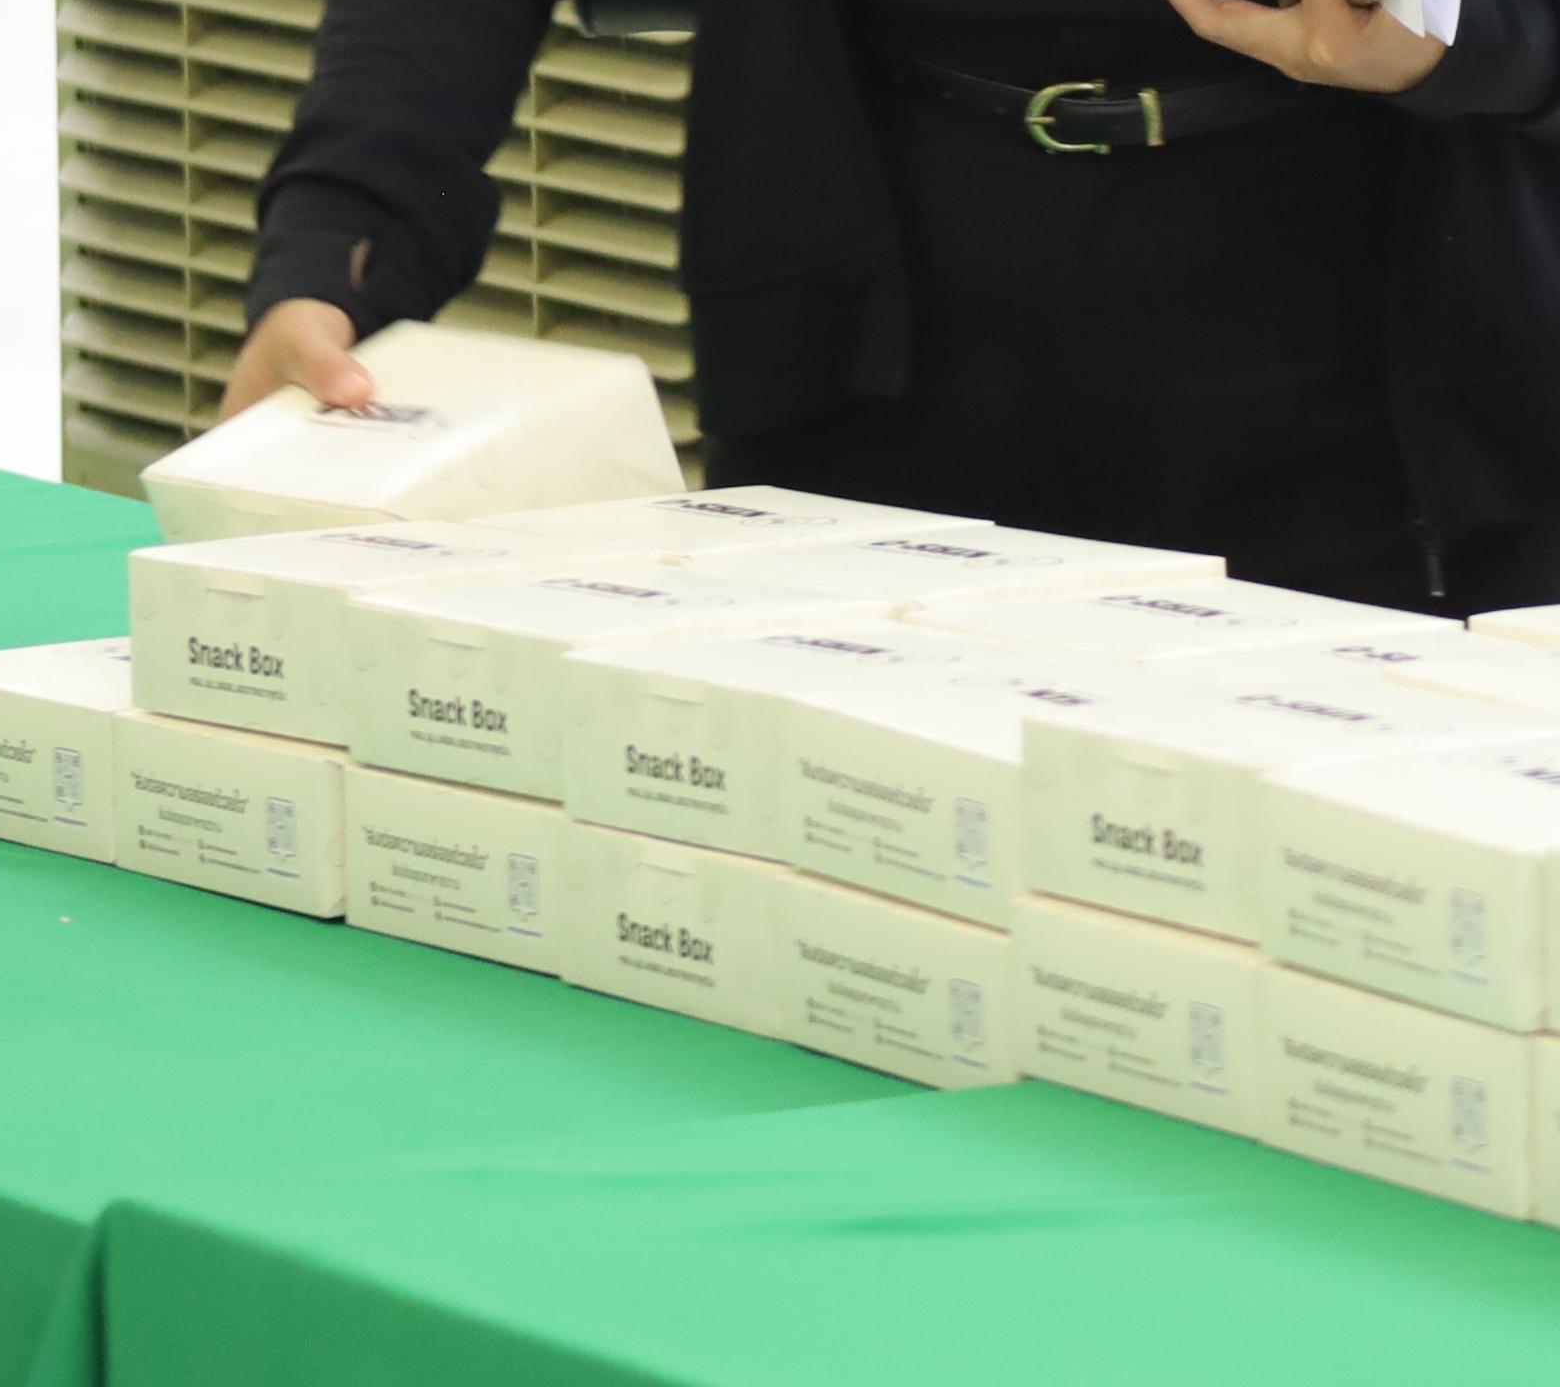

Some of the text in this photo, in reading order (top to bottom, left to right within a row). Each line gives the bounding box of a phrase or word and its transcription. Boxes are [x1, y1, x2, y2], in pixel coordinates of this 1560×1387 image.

[188, 636, 285, 679] Snack Box
[408, 688, 509, 735] Snack Box
[626, 744, 728, 791] Snack Box
[1091, 811, 1206, 867] Snack Box
[618, 912, 715, 965] Snack Box
